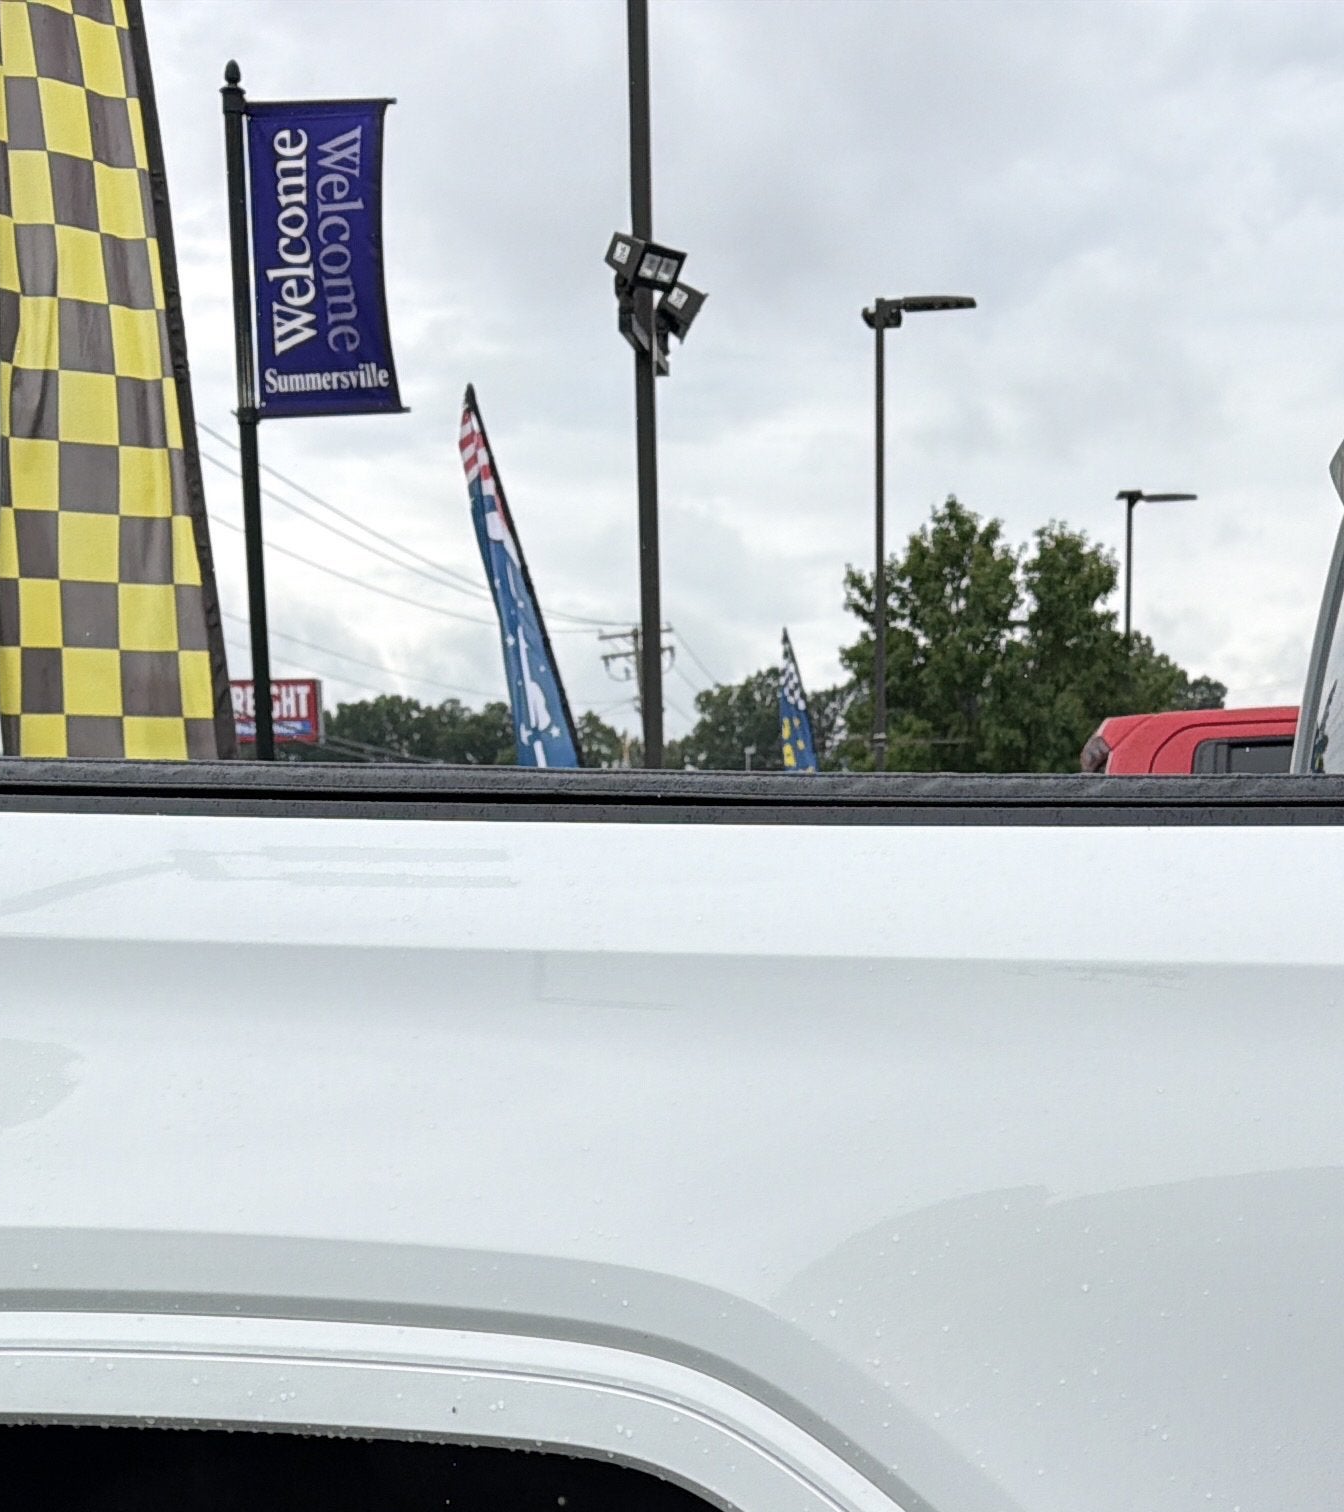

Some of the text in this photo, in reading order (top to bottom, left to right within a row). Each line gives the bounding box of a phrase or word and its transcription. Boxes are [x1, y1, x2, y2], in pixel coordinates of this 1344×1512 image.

[266, 128, 318, 357] Welcome
[315, 125, 365, 354] Welcome
[264, 362, 390, 395] Summersville
